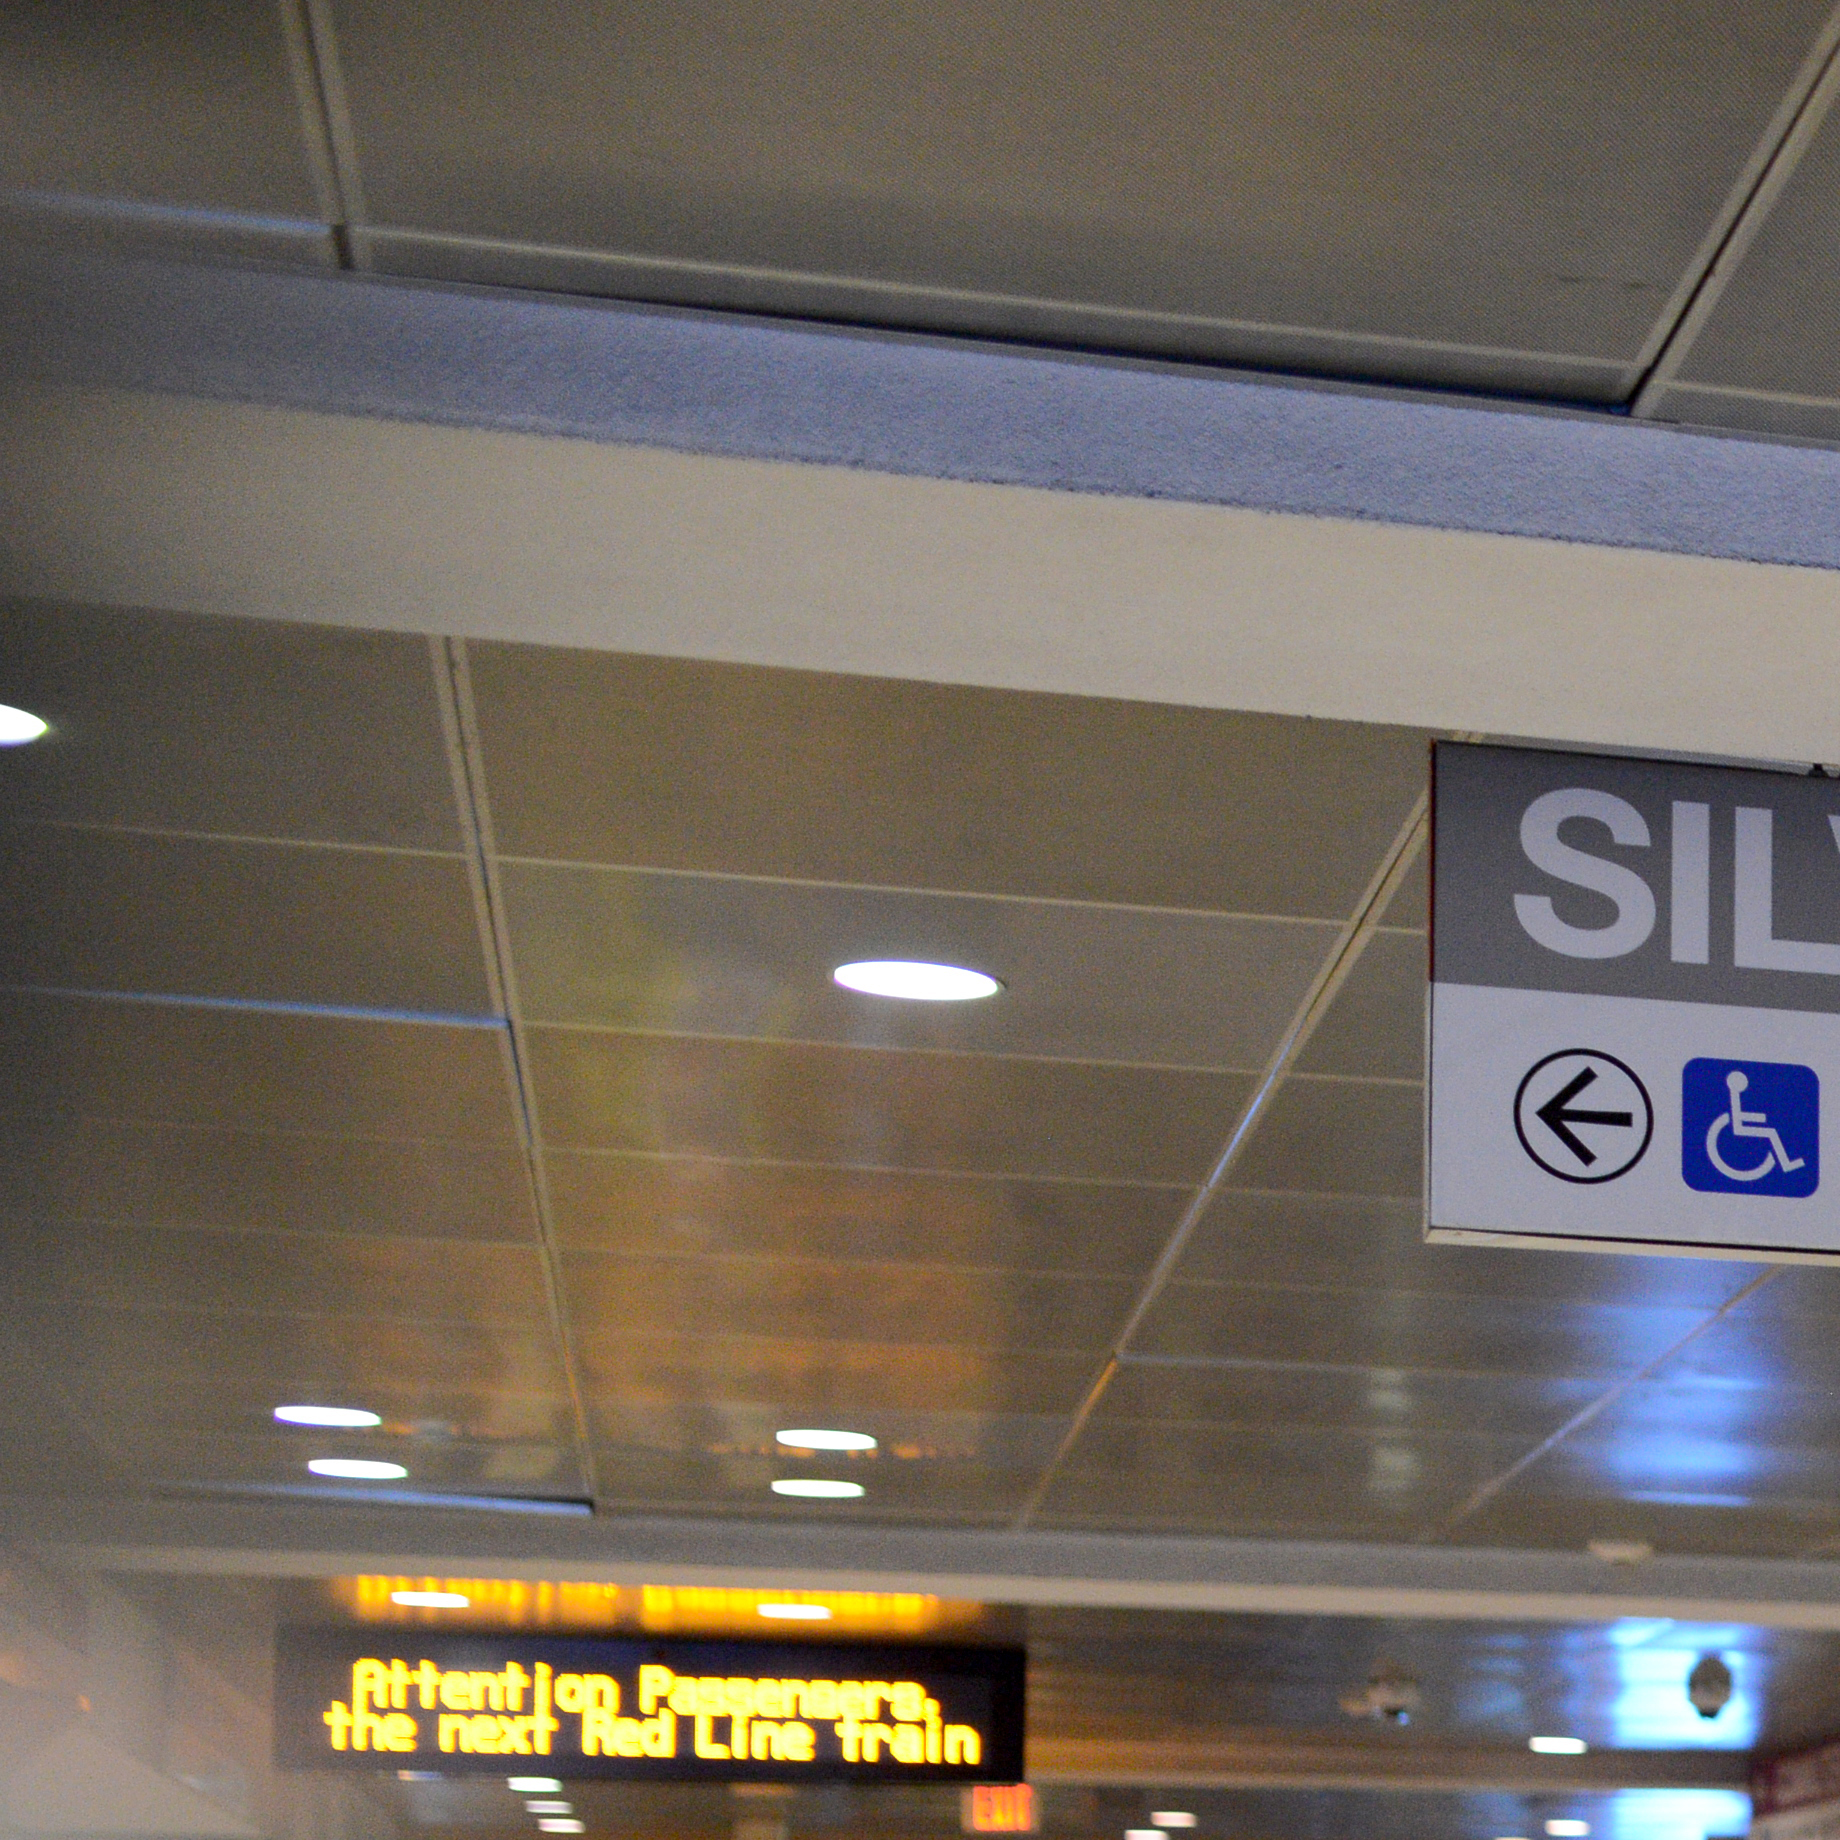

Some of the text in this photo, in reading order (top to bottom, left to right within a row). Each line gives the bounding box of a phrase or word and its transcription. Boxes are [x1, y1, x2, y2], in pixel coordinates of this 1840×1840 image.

[352, 1658, 620, 1714] Attention
[323, 1700, 982, 1766] the next Red Line train
